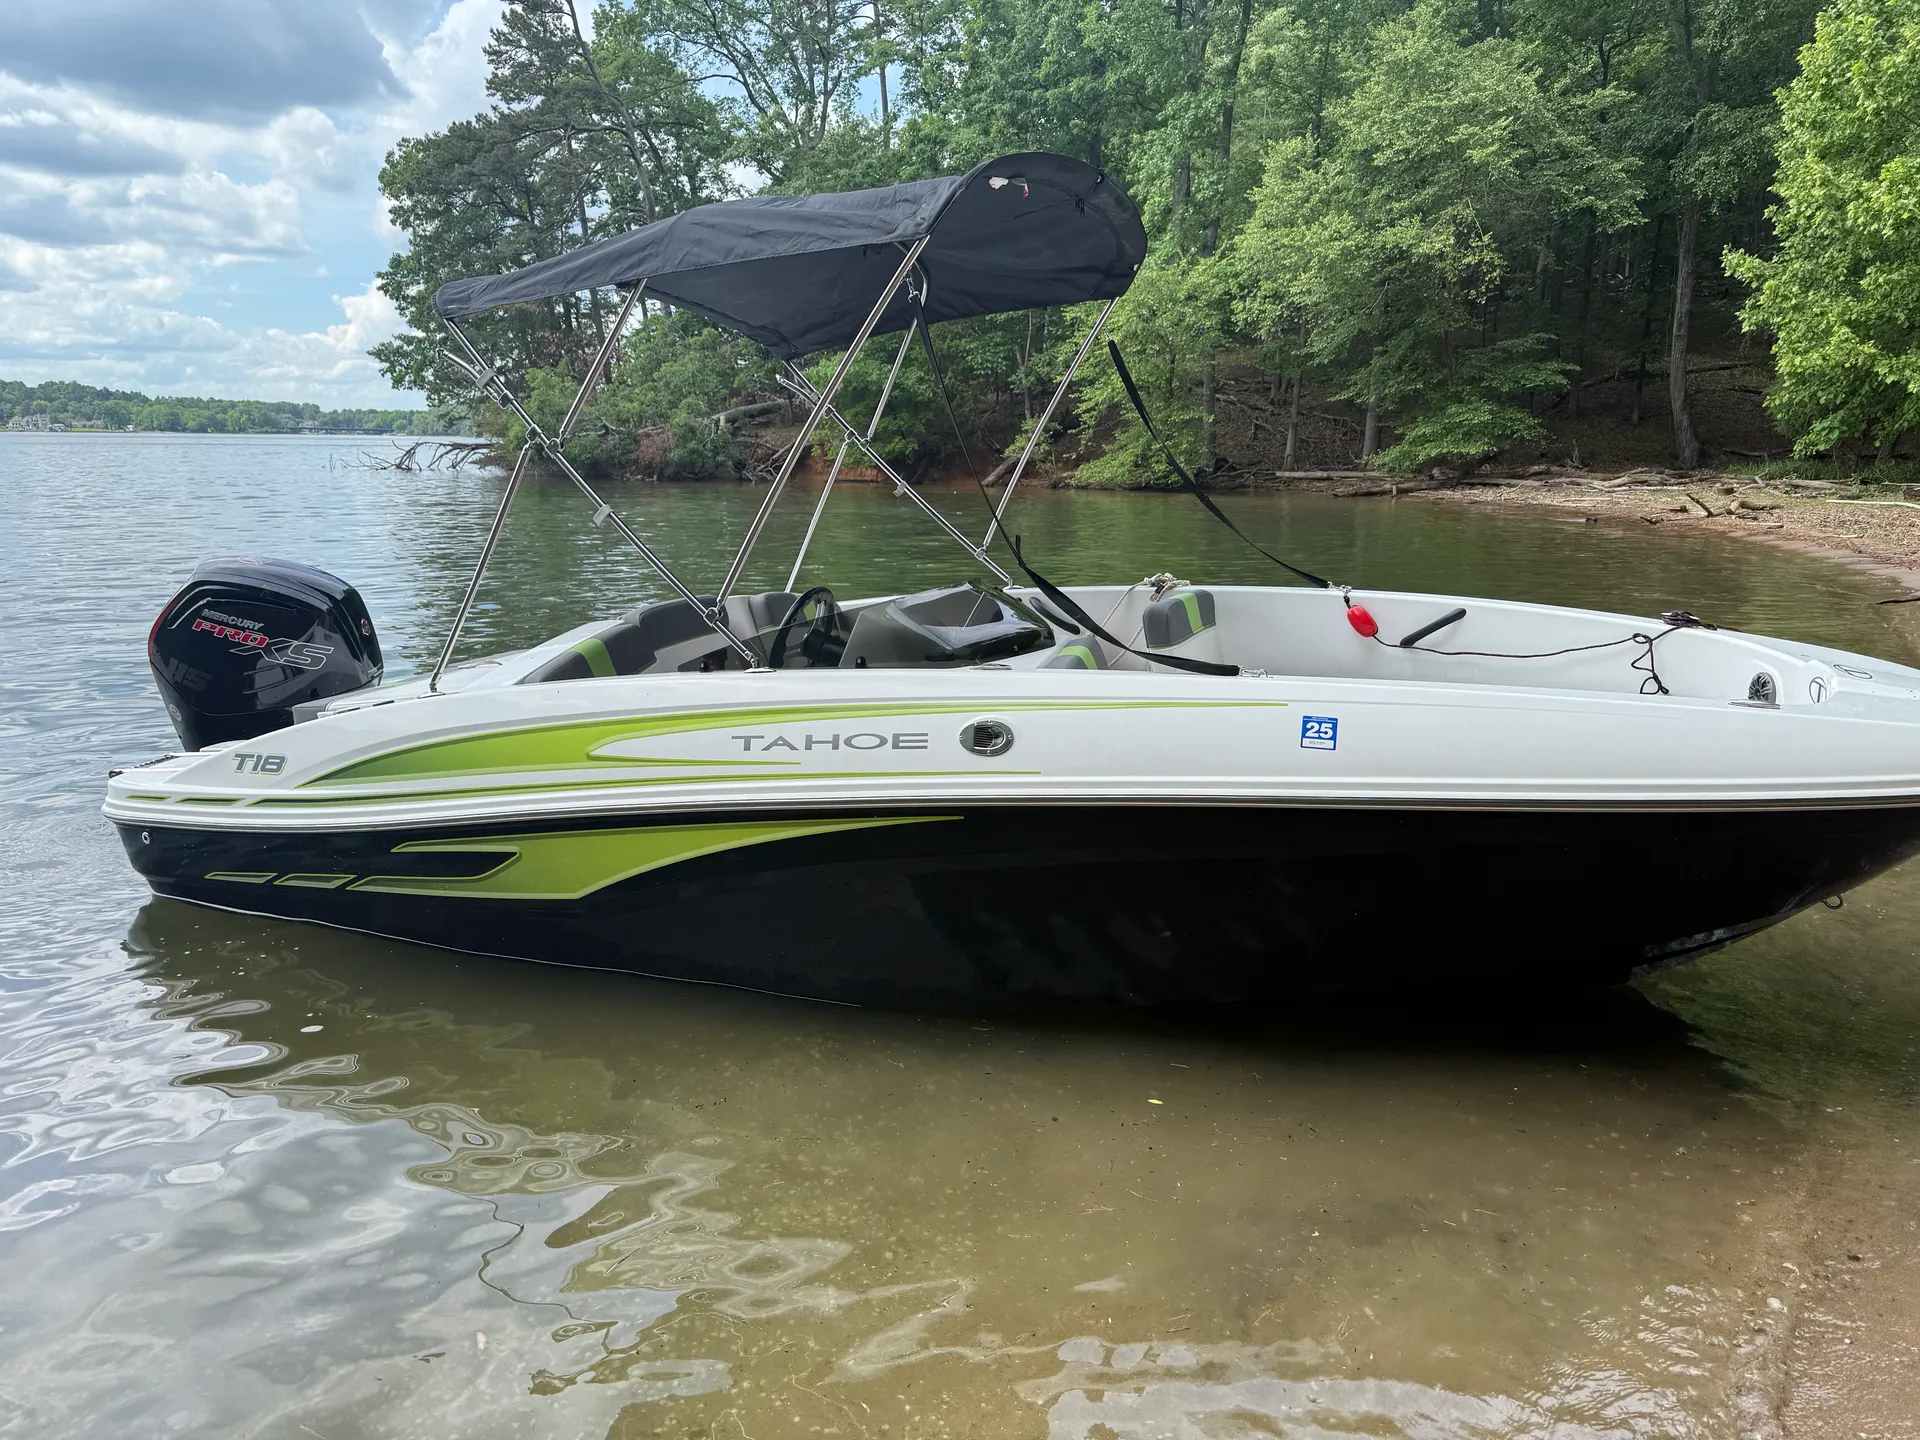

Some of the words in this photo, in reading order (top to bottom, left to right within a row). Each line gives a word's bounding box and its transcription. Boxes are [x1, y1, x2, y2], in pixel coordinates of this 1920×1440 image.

[201, 608, 265, 630] MERCURY
[192, 619, 269, 648] PRO
[229, 637, 334, 670] XS
[1305, 721, 1333, 739] 25
[731, 732, 928, 751] TAHOE
[232, 752, 287, 775] T18
